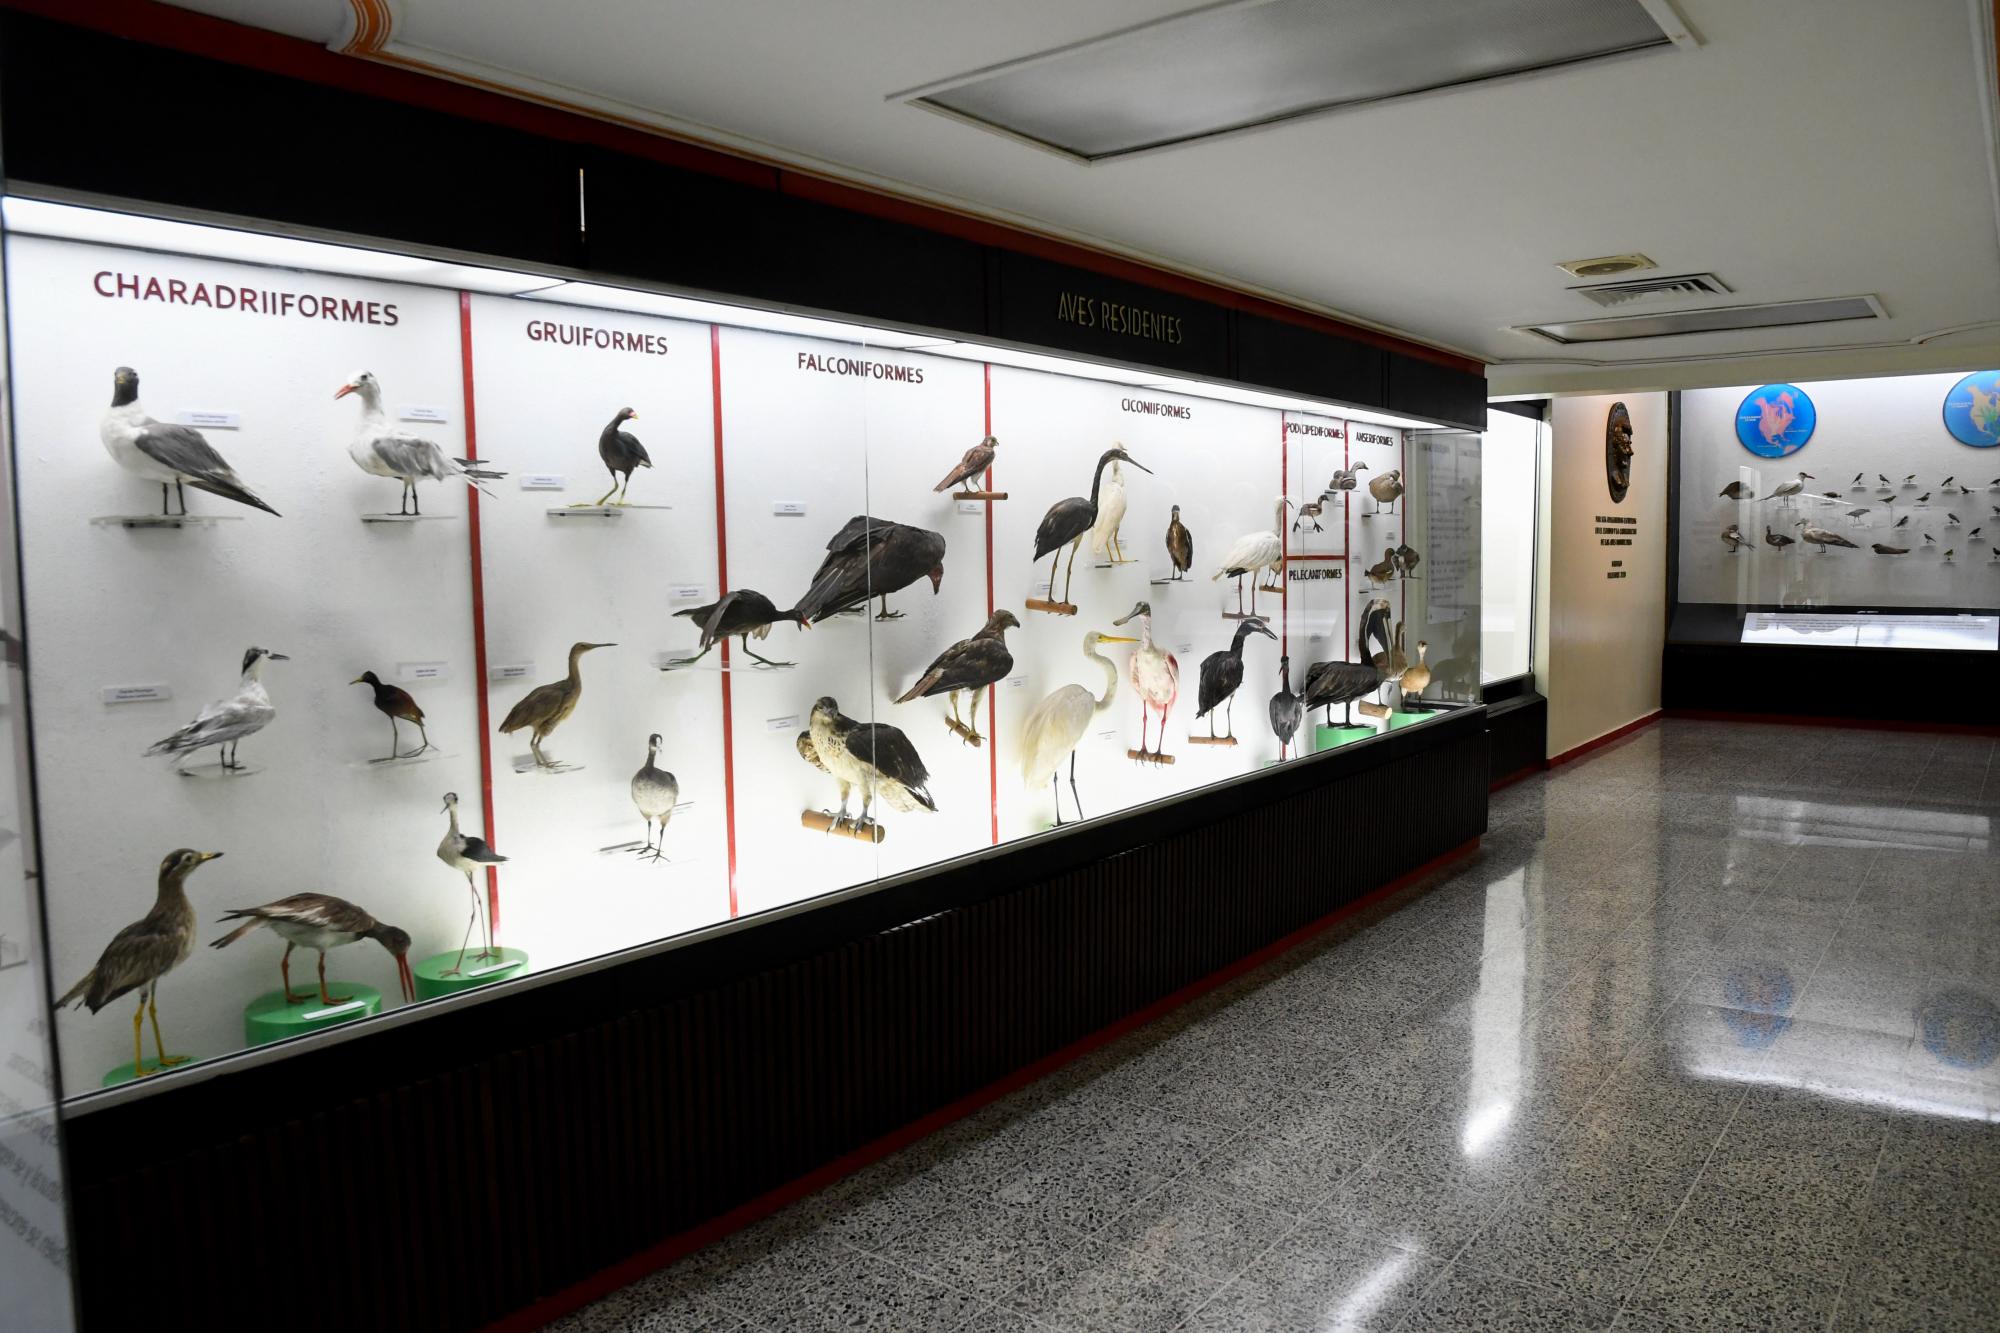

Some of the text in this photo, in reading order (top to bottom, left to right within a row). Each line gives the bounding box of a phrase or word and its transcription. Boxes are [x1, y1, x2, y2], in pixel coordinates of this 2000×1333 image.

[94, 271, 399, 326] CHARADRIIFORMES
[1058, 291, 1182, 344] AVES RESIDENTES
[527, 320, 668, 355] GRUIFORMES
[798, 352, 924, 384] FALCONIFORMES
[1121, 398, 1191, 420] CICONIIFORMES
